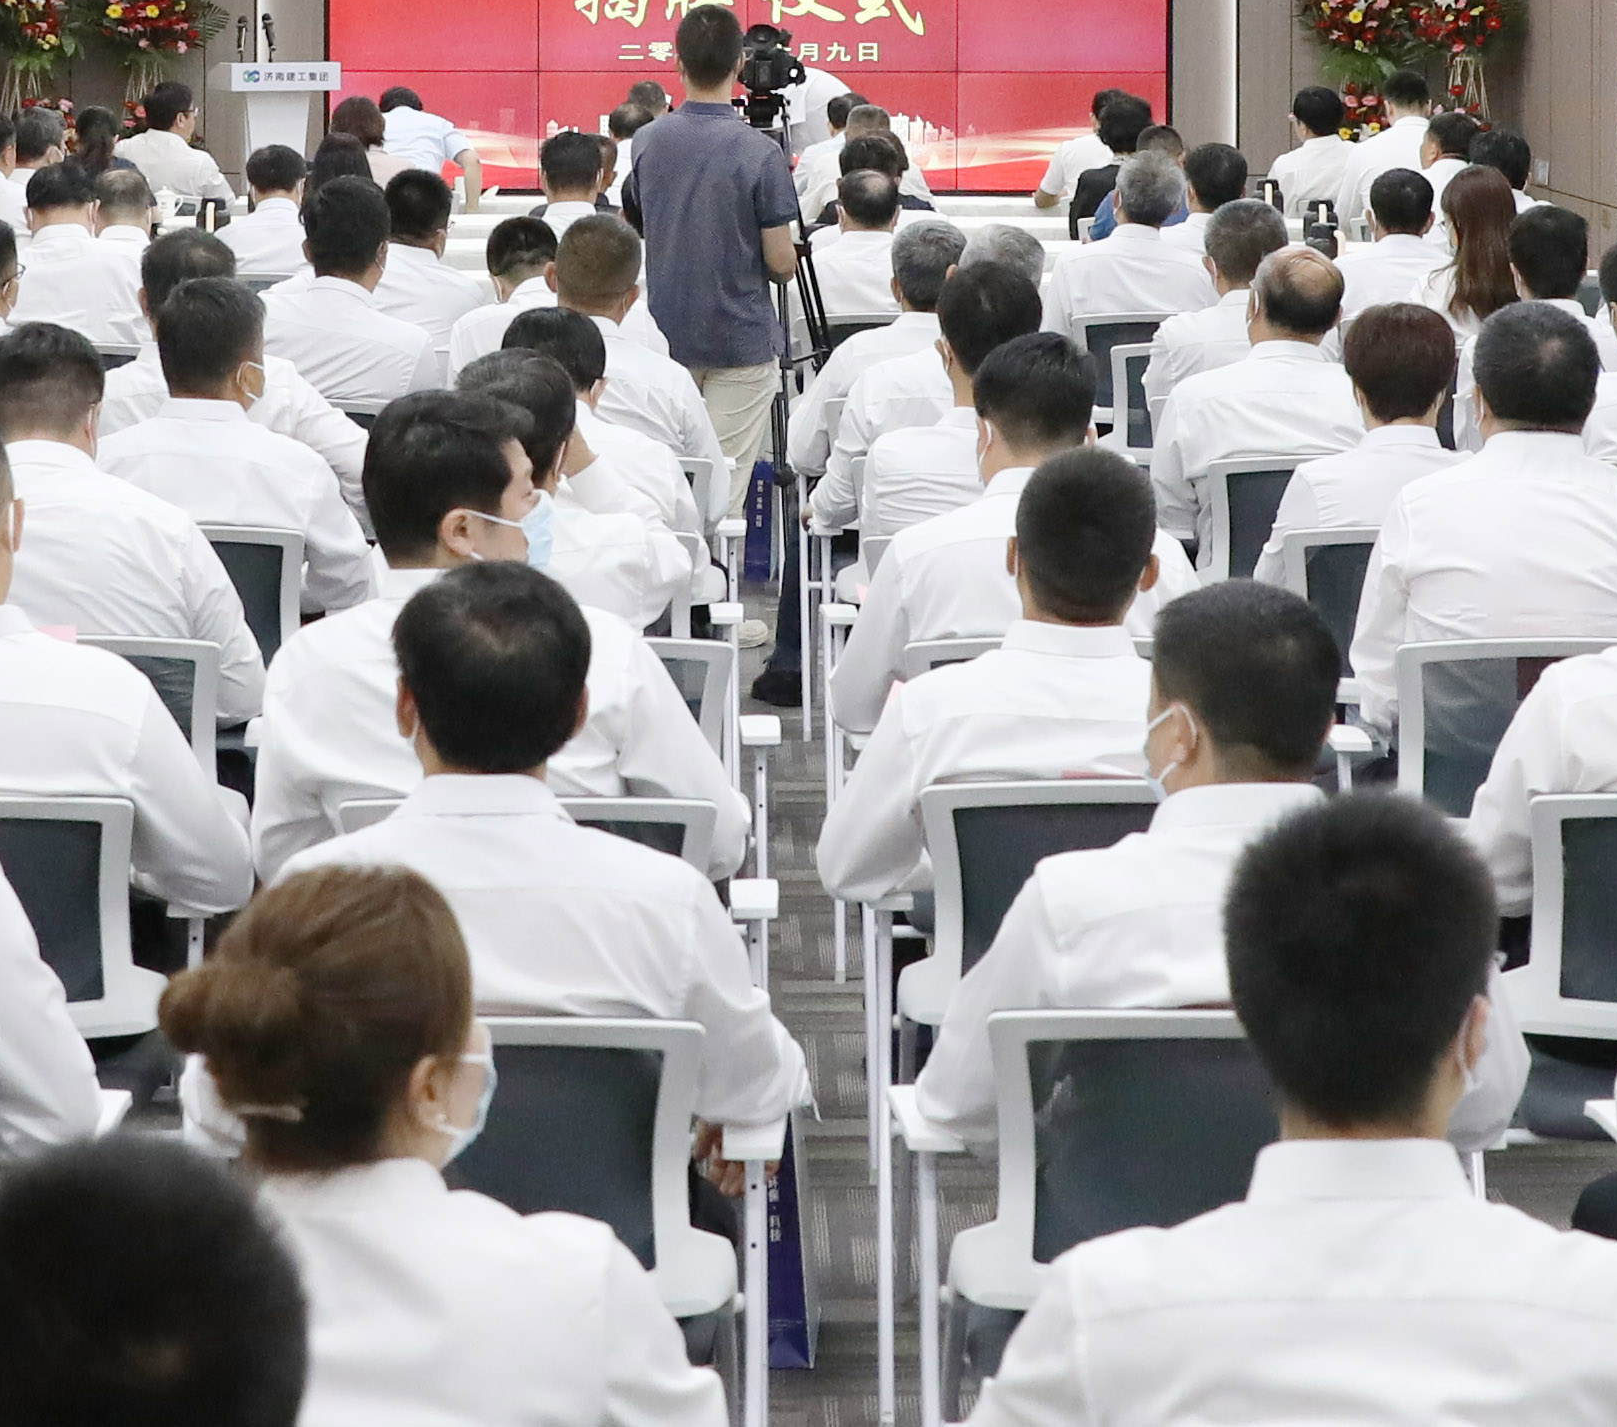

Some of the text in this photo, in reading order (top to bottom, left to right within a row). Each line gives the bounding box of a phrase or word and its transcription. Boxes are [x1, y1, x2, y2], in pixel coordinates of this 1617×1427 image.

[618, 40, 880, 63] 二零月九日
[263, 71, 330, 83] 济南建工集团
